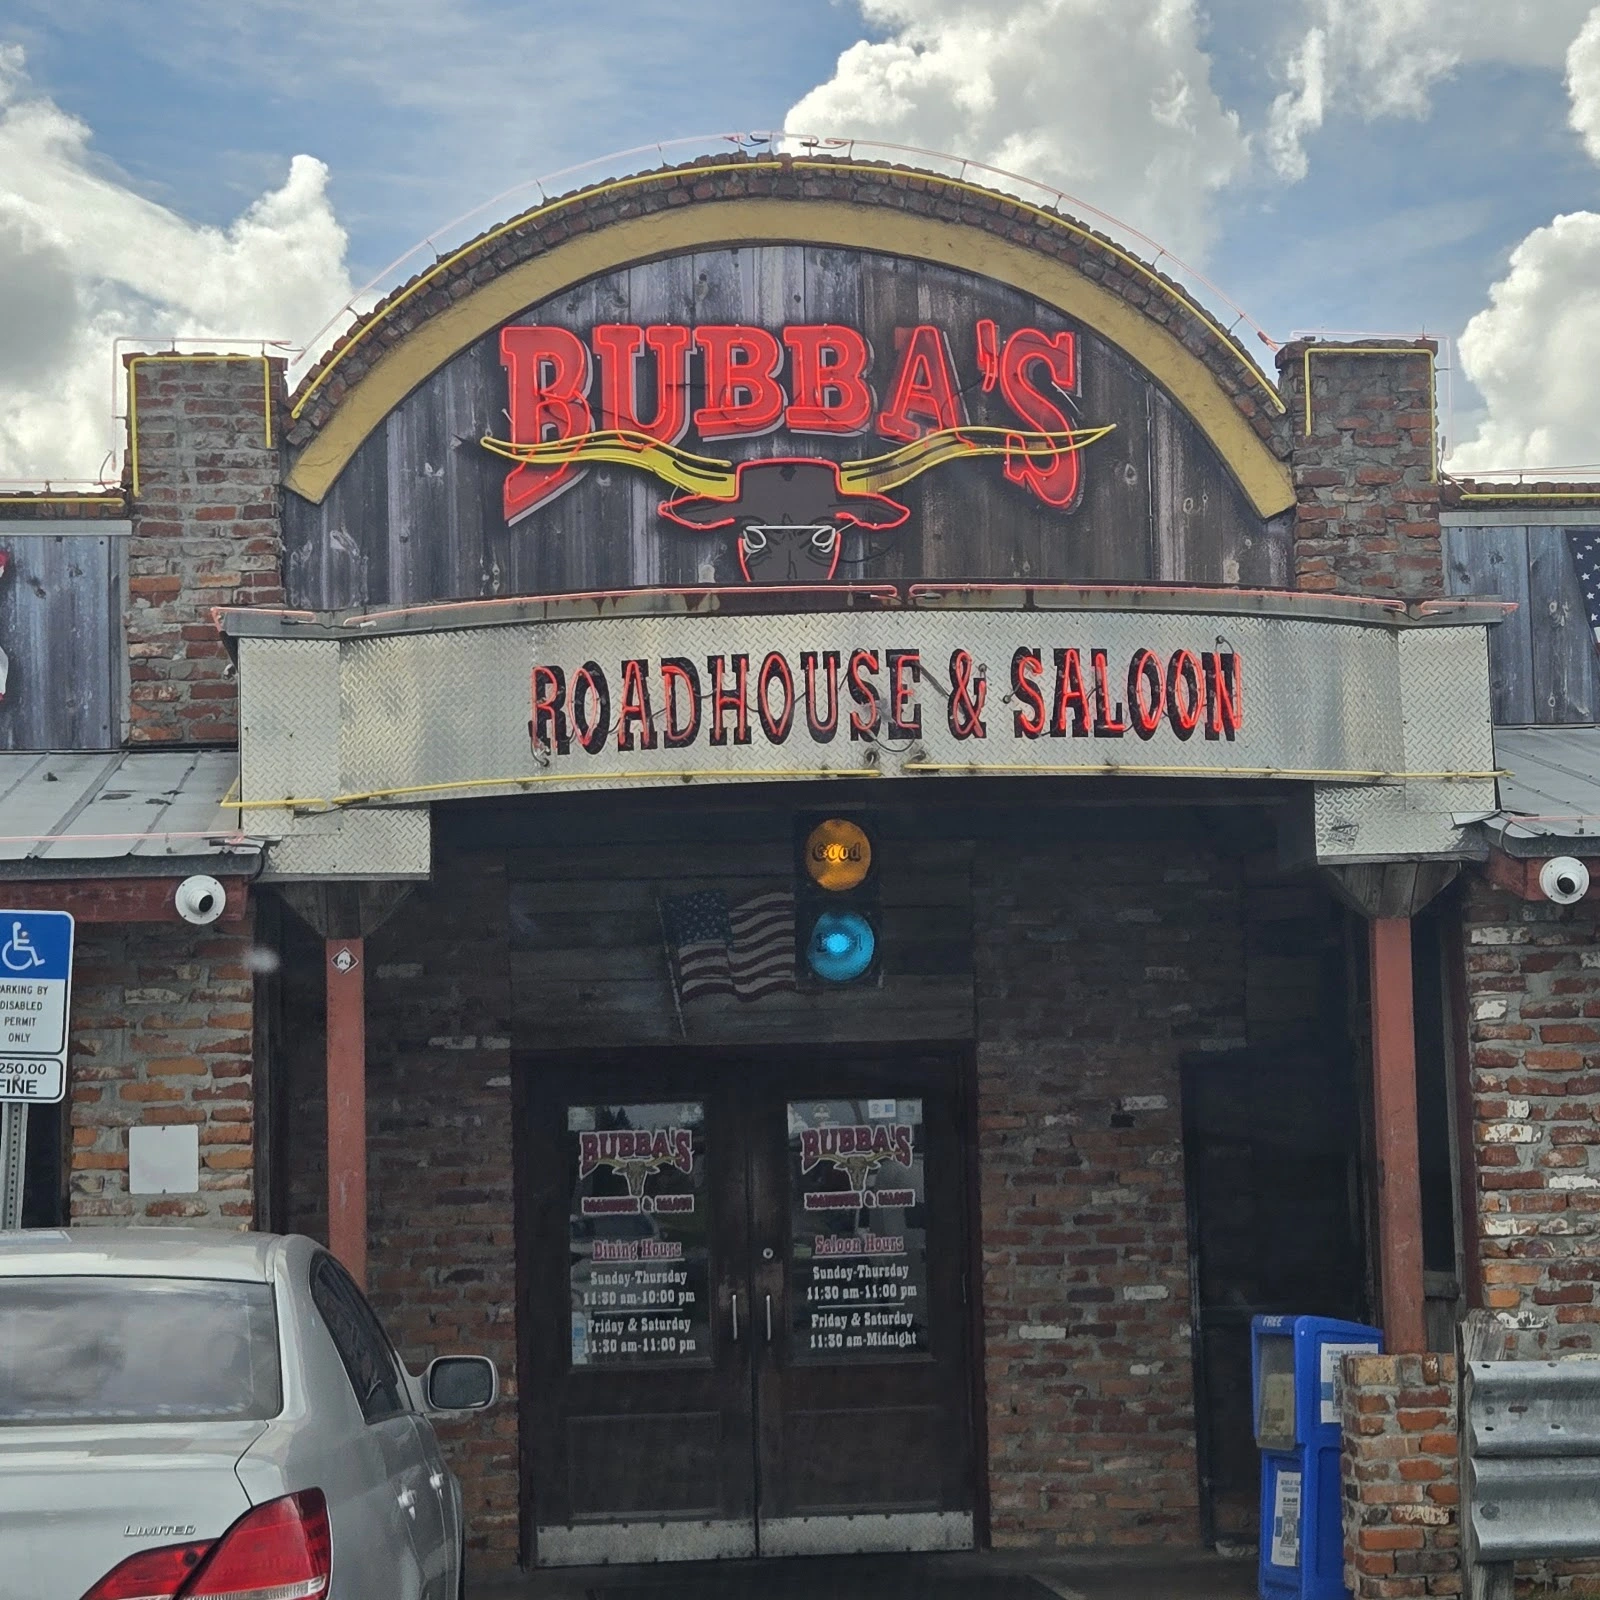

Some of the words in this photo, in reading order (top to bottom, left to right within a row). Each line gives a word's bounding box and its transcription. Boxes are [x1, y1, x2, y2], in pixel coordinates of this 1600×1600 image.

[500, 320, 1082, 526] BUBBA'S
[528, 648, 921, 755] ROADHOUSE
[948, 649, 987, 740] &
[1010, 646, 1243, 742] SALOON
[0, 985, 33, 995] ARKING
[37, 986, 49, 996] BY
[0, 1001, 43, 1011] DISABLED
[4, 1017, 36, 1027] PERMIT
[8, 1033, 31, 1042] ONLY
[579, 1127, 694, 1180] BUBBA'S
[800, 1123, 914, 1175] BUBBA'S
[592, 1239, 639, 1260] Dining
[641, 1238, 682, 1257] Hours
[815, 1234, 862, 1254] Saloon
[863, 1233, 905, 1252] Hours
[591, 1270, 687, 1287] Sunday-Thursday
[813, 1263, 909, 1281] Sunday-Thursday
[584, 1292, 616, 1305] 11:30
[678, 1291, 696, 1305] pm
[807, 1286, 839, 1300] 11:30
[901, 1285, 917, 1300] pm
[587, 1319, 624, 1335] Friday
[628, 1318, 637, 1331] &
[641, 1317, 691, 1333] Saturday
[811, 1314, 848, 1329] Friday
[851, 1313, 861, 1326] &
[864, 1311, 913, 1327] Saturday
[1262, 1316, 1284, 1327] FREE
[585, 1339, 617, 1353] 11:30
[680, 1339, 696, 1354] pm
[811, 1334, 843, 1348] 11:30
[124, 1525, 196, 1537] LIMITED
